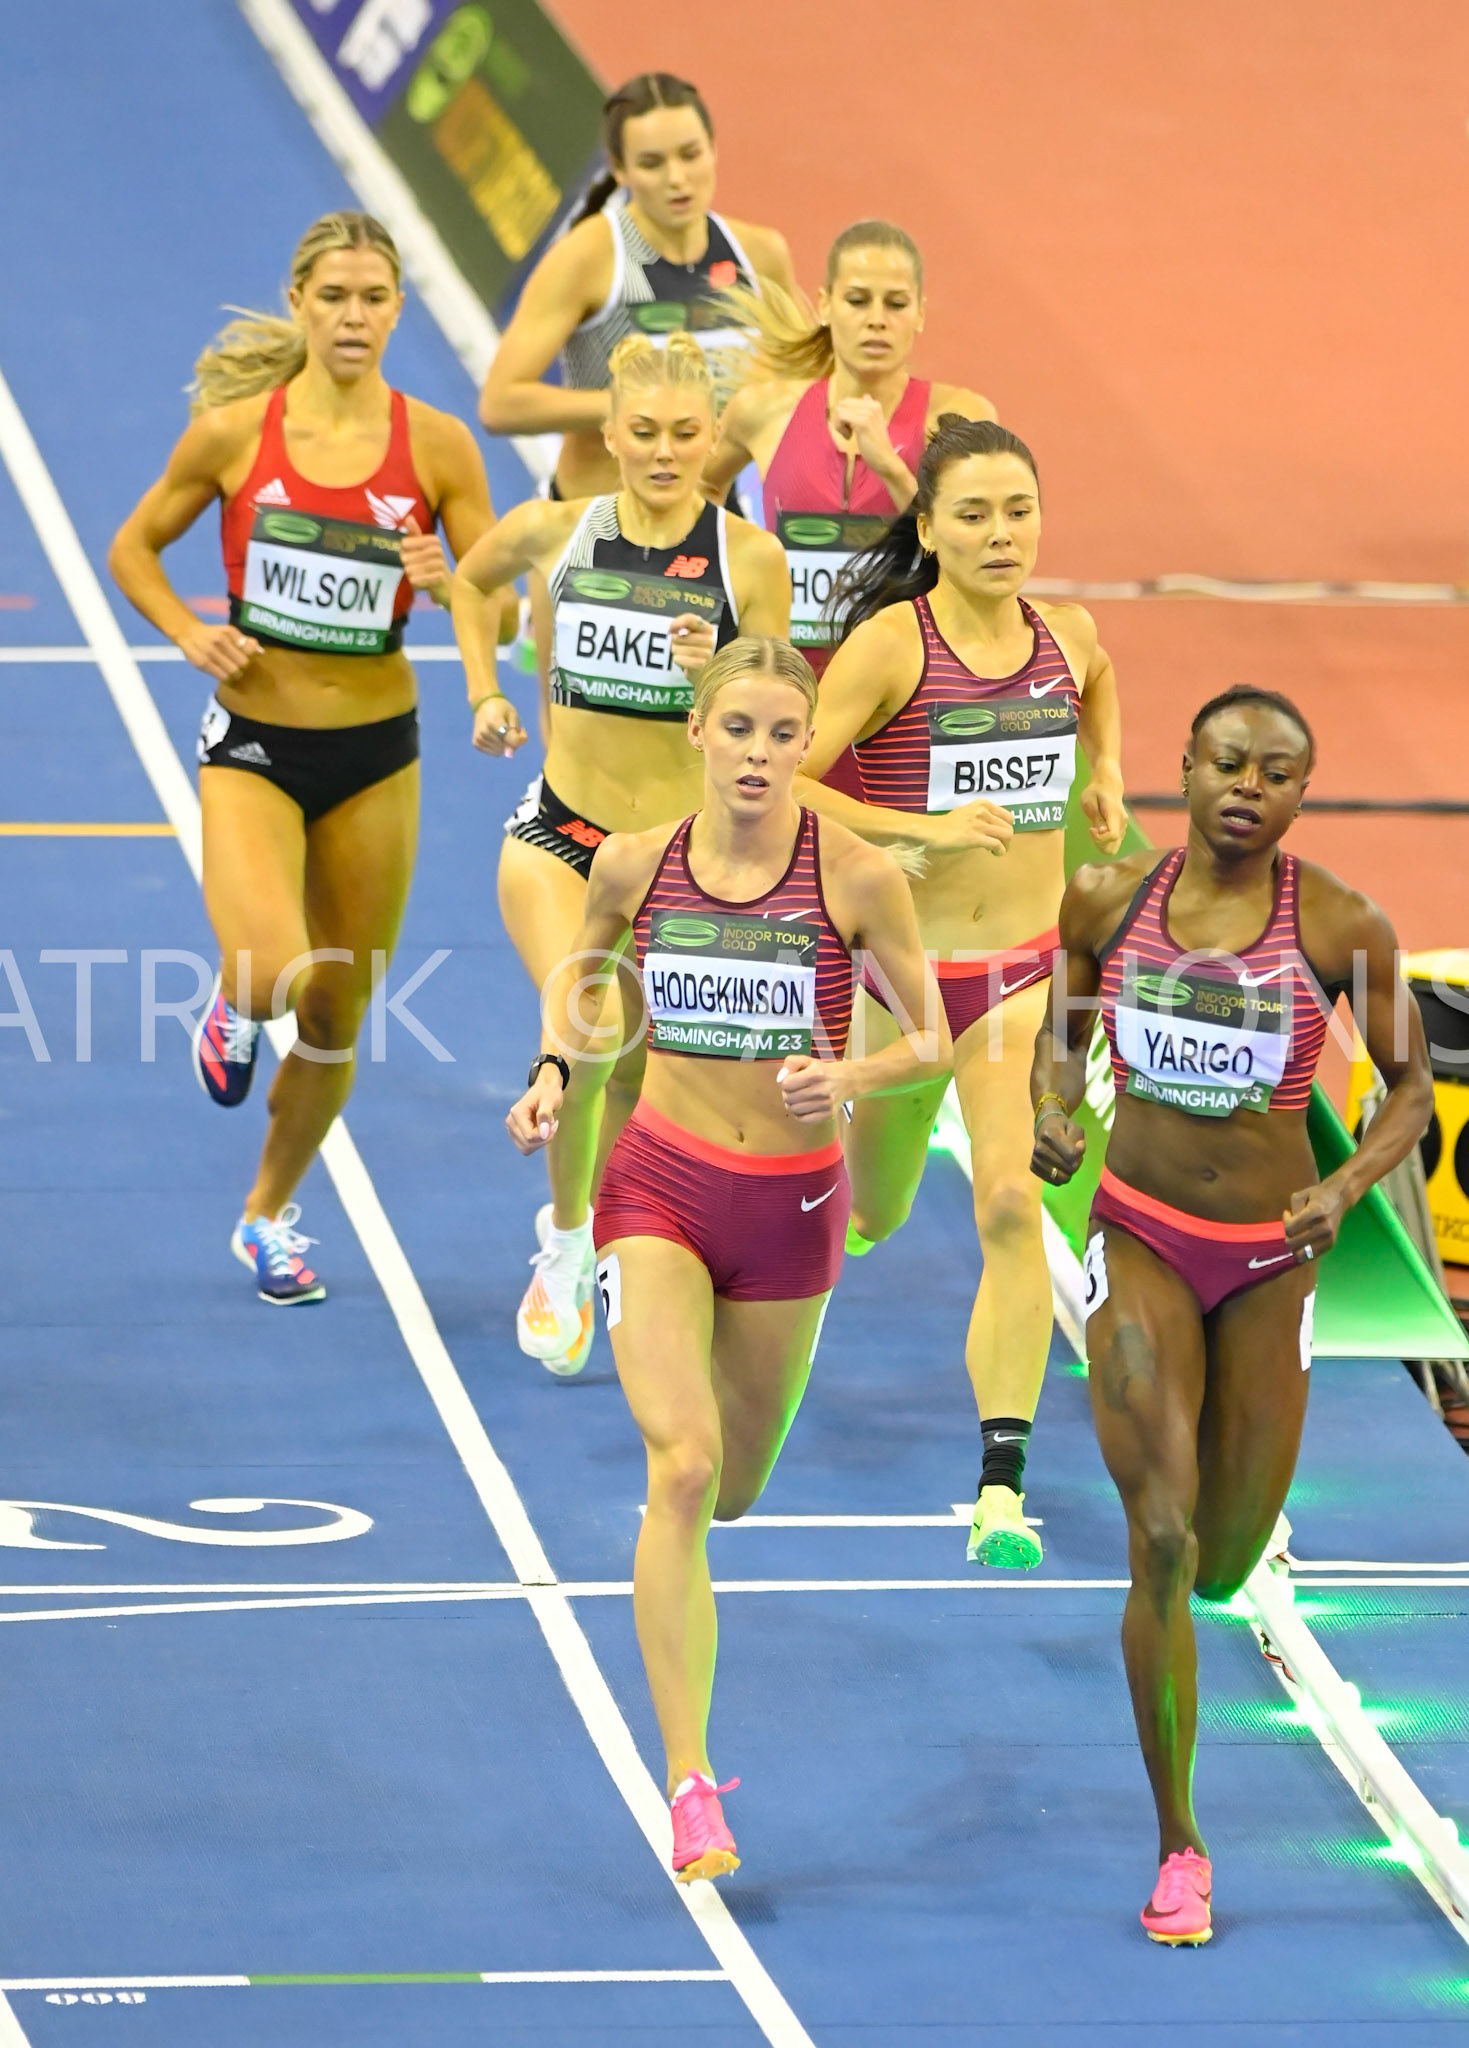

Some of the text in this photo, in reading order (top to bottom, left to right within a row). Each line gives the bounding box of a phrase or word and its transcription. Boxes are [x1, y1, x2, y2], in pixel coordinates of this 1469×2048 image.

[262, 559, 382, 613] WILSON
[683, 591, 715, 609] TOUR
[248, 605, 378, 646] BIRMINGHAM 23
[576, 620, 673, 671] BAKE
[1000, 708, 1069, 722] INDOOR TOUR
[1001, 720, 1031, 732] GOLD
[954, 753, 1060, 794] BISSET
[1052, 806, 1063, 822] 23
[722, 939, 757, 952] GOLD
[723, 928, 810, 947] INDOOR TOUR
[652, 970, 805, 1017] HODGKINSON
[1197, 991, 1284, 1014] INDOOR TOUR
[1195, 1001, 1231, 1017] GOLD
[657, 1025, 803, 1051] BIRMINGHAM 23
[1145, 1028, 1254, 1076] YARIGO
